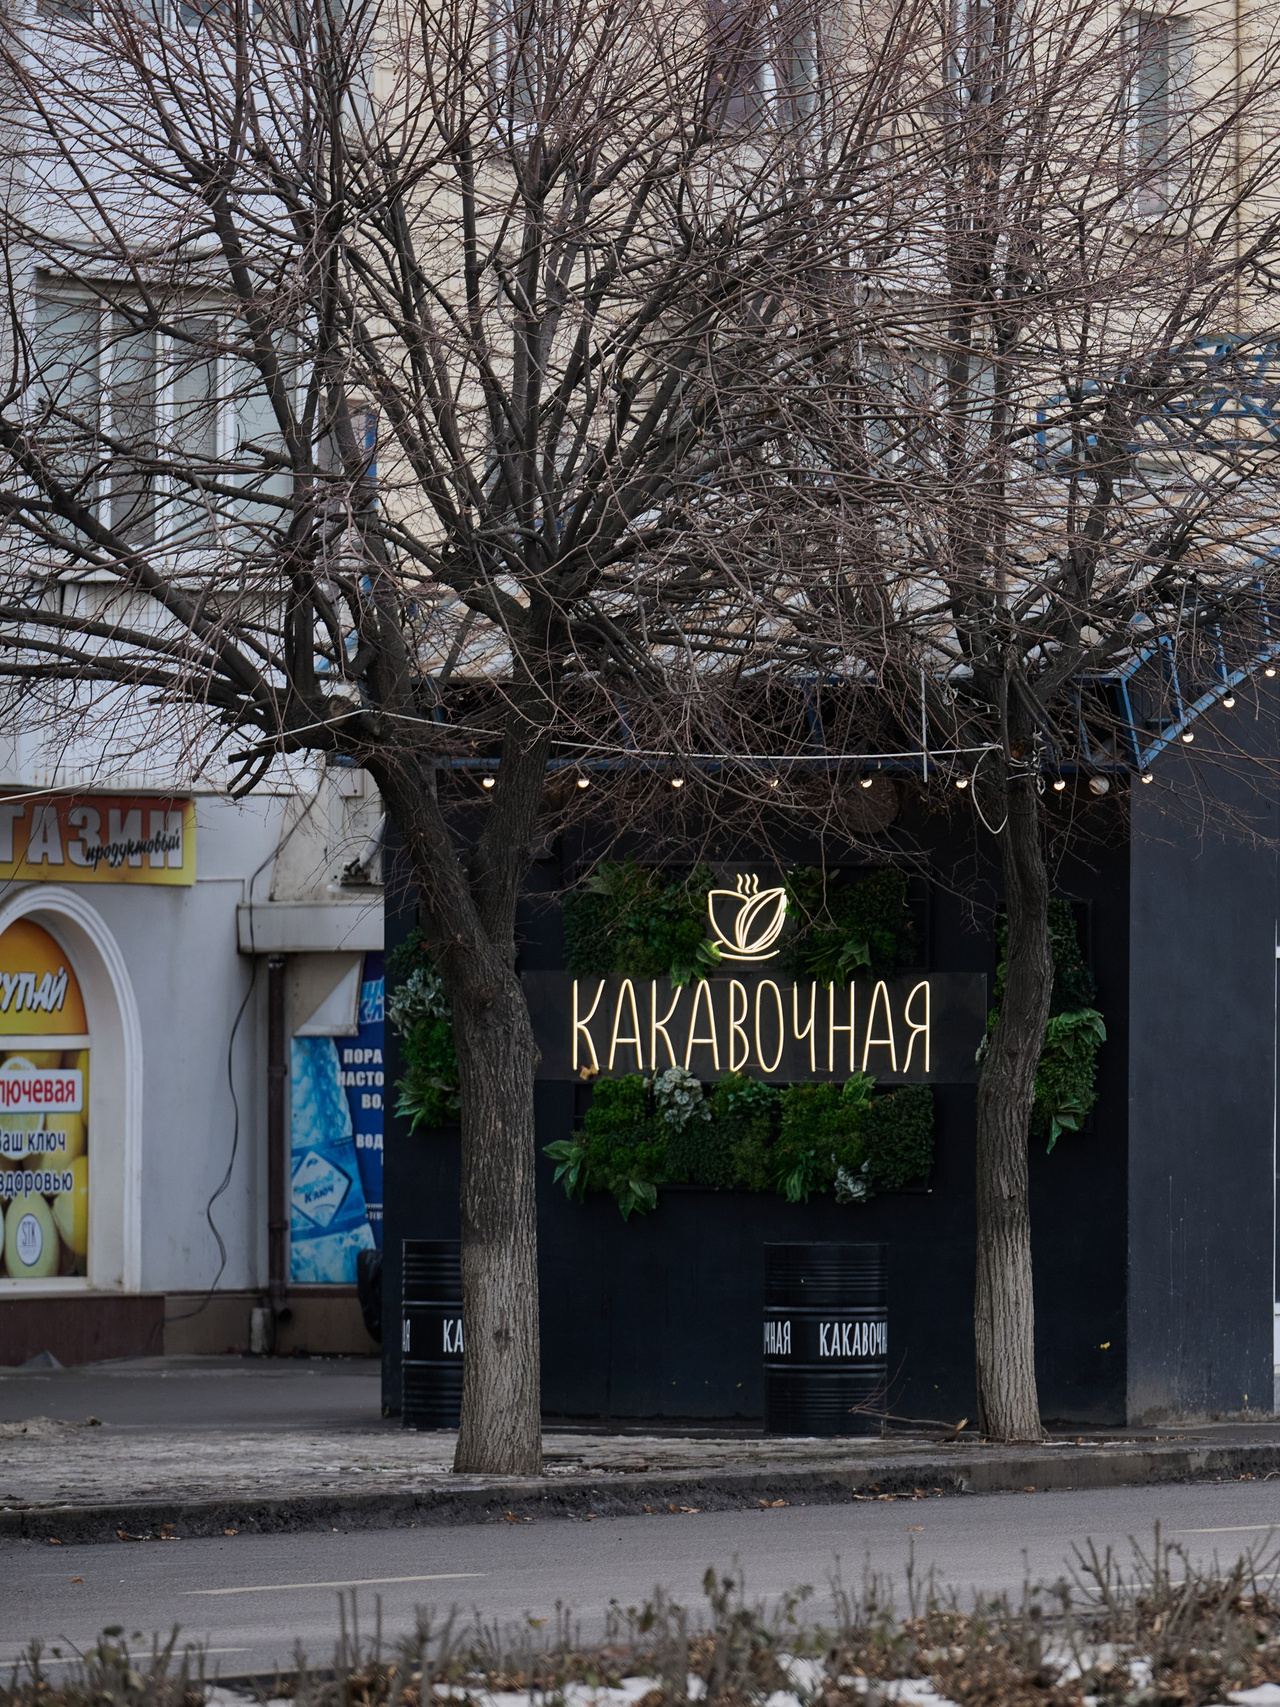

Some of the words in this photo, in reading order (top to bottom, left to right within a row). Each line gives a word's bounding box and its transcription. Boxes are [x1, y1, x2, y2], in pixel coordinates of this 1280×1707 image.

[85, 827, 182, 873] продуктовый
[0, 965, 69, 1012] УПАЙ
[572, 978, 931, 1074] КАКАВОЧНАЯ
[0, 1130, 23, 1151] аш
[28, 1132, 66, 1151] ключ
